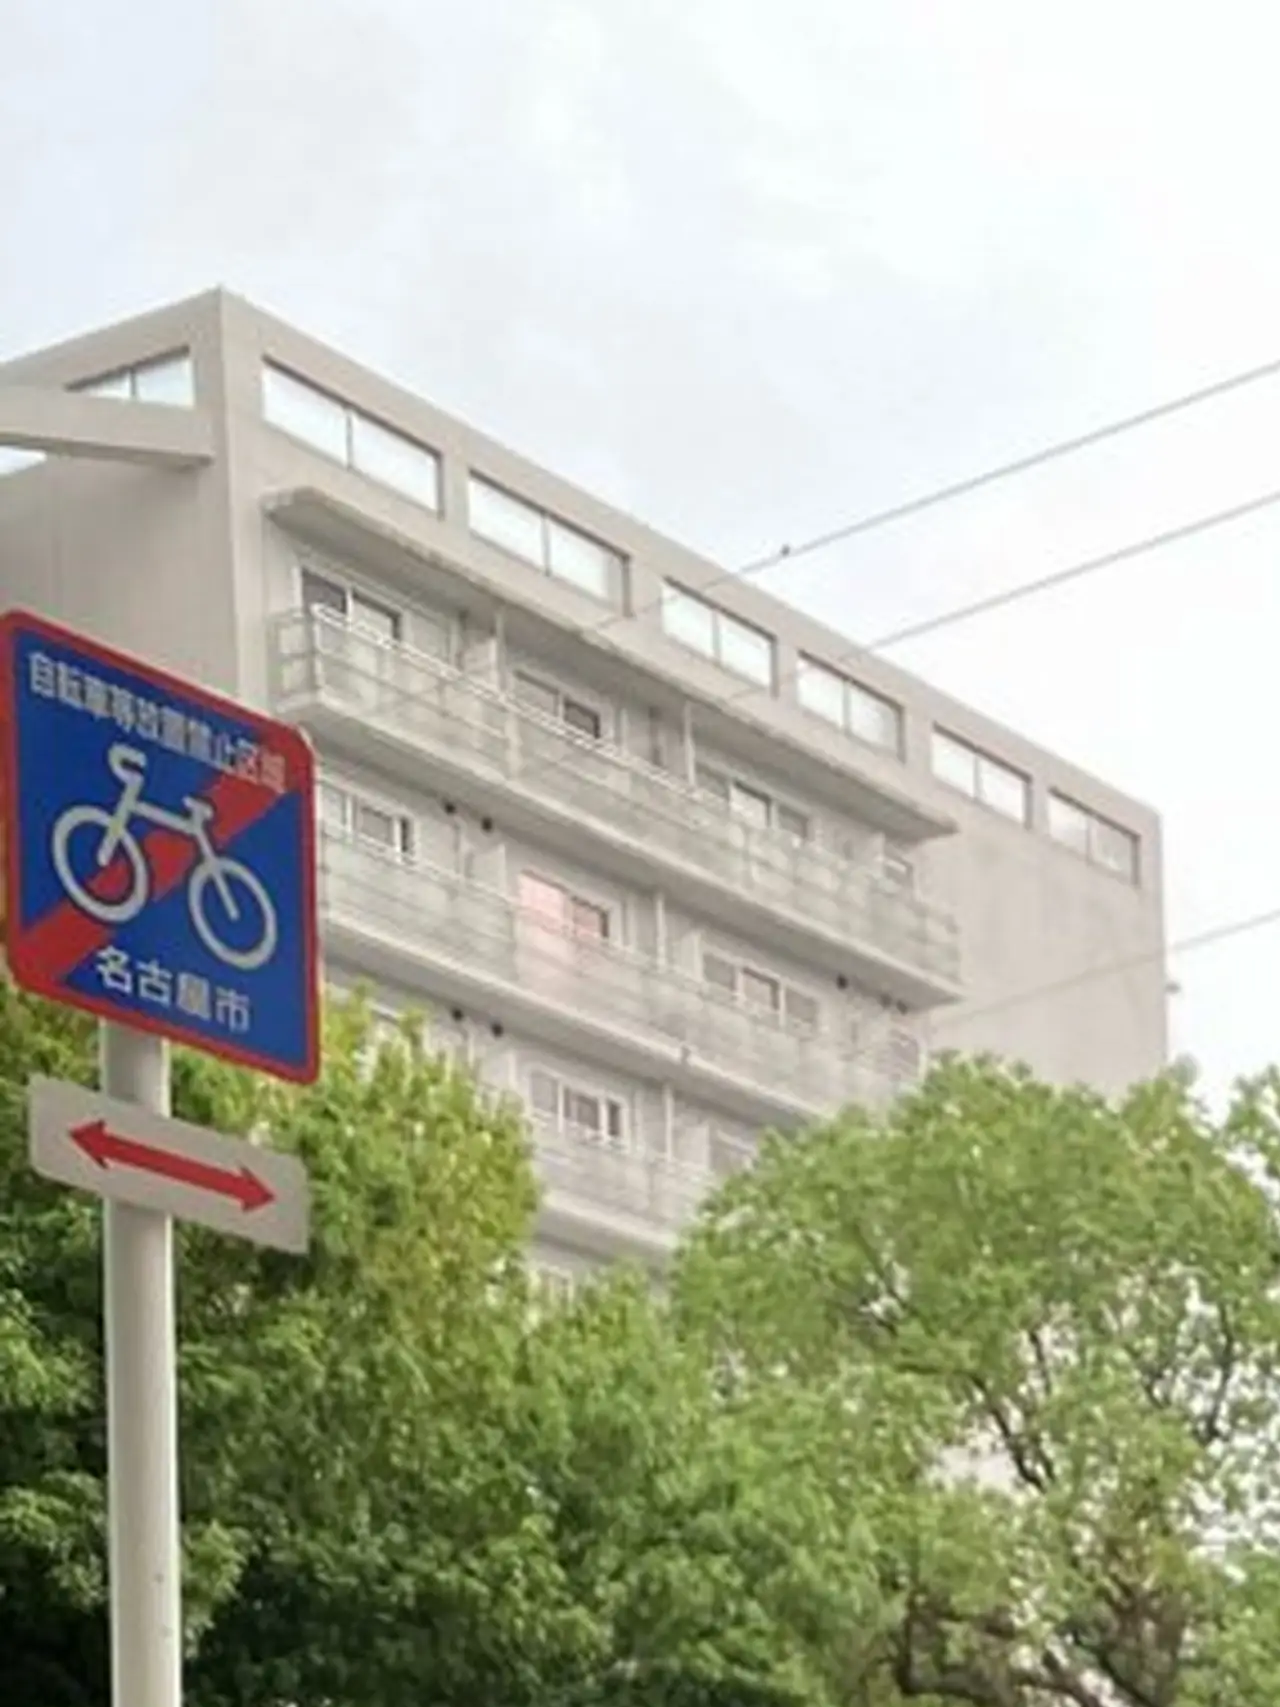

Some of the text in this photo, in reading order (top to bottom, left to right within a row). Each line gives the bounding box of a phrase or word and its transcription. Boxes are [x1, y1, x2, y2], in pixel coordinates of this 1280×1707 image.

[28, 652, 285, 792] 自転車等放置禁止区域
[97, 947, 250, 1033] 名古屋市
